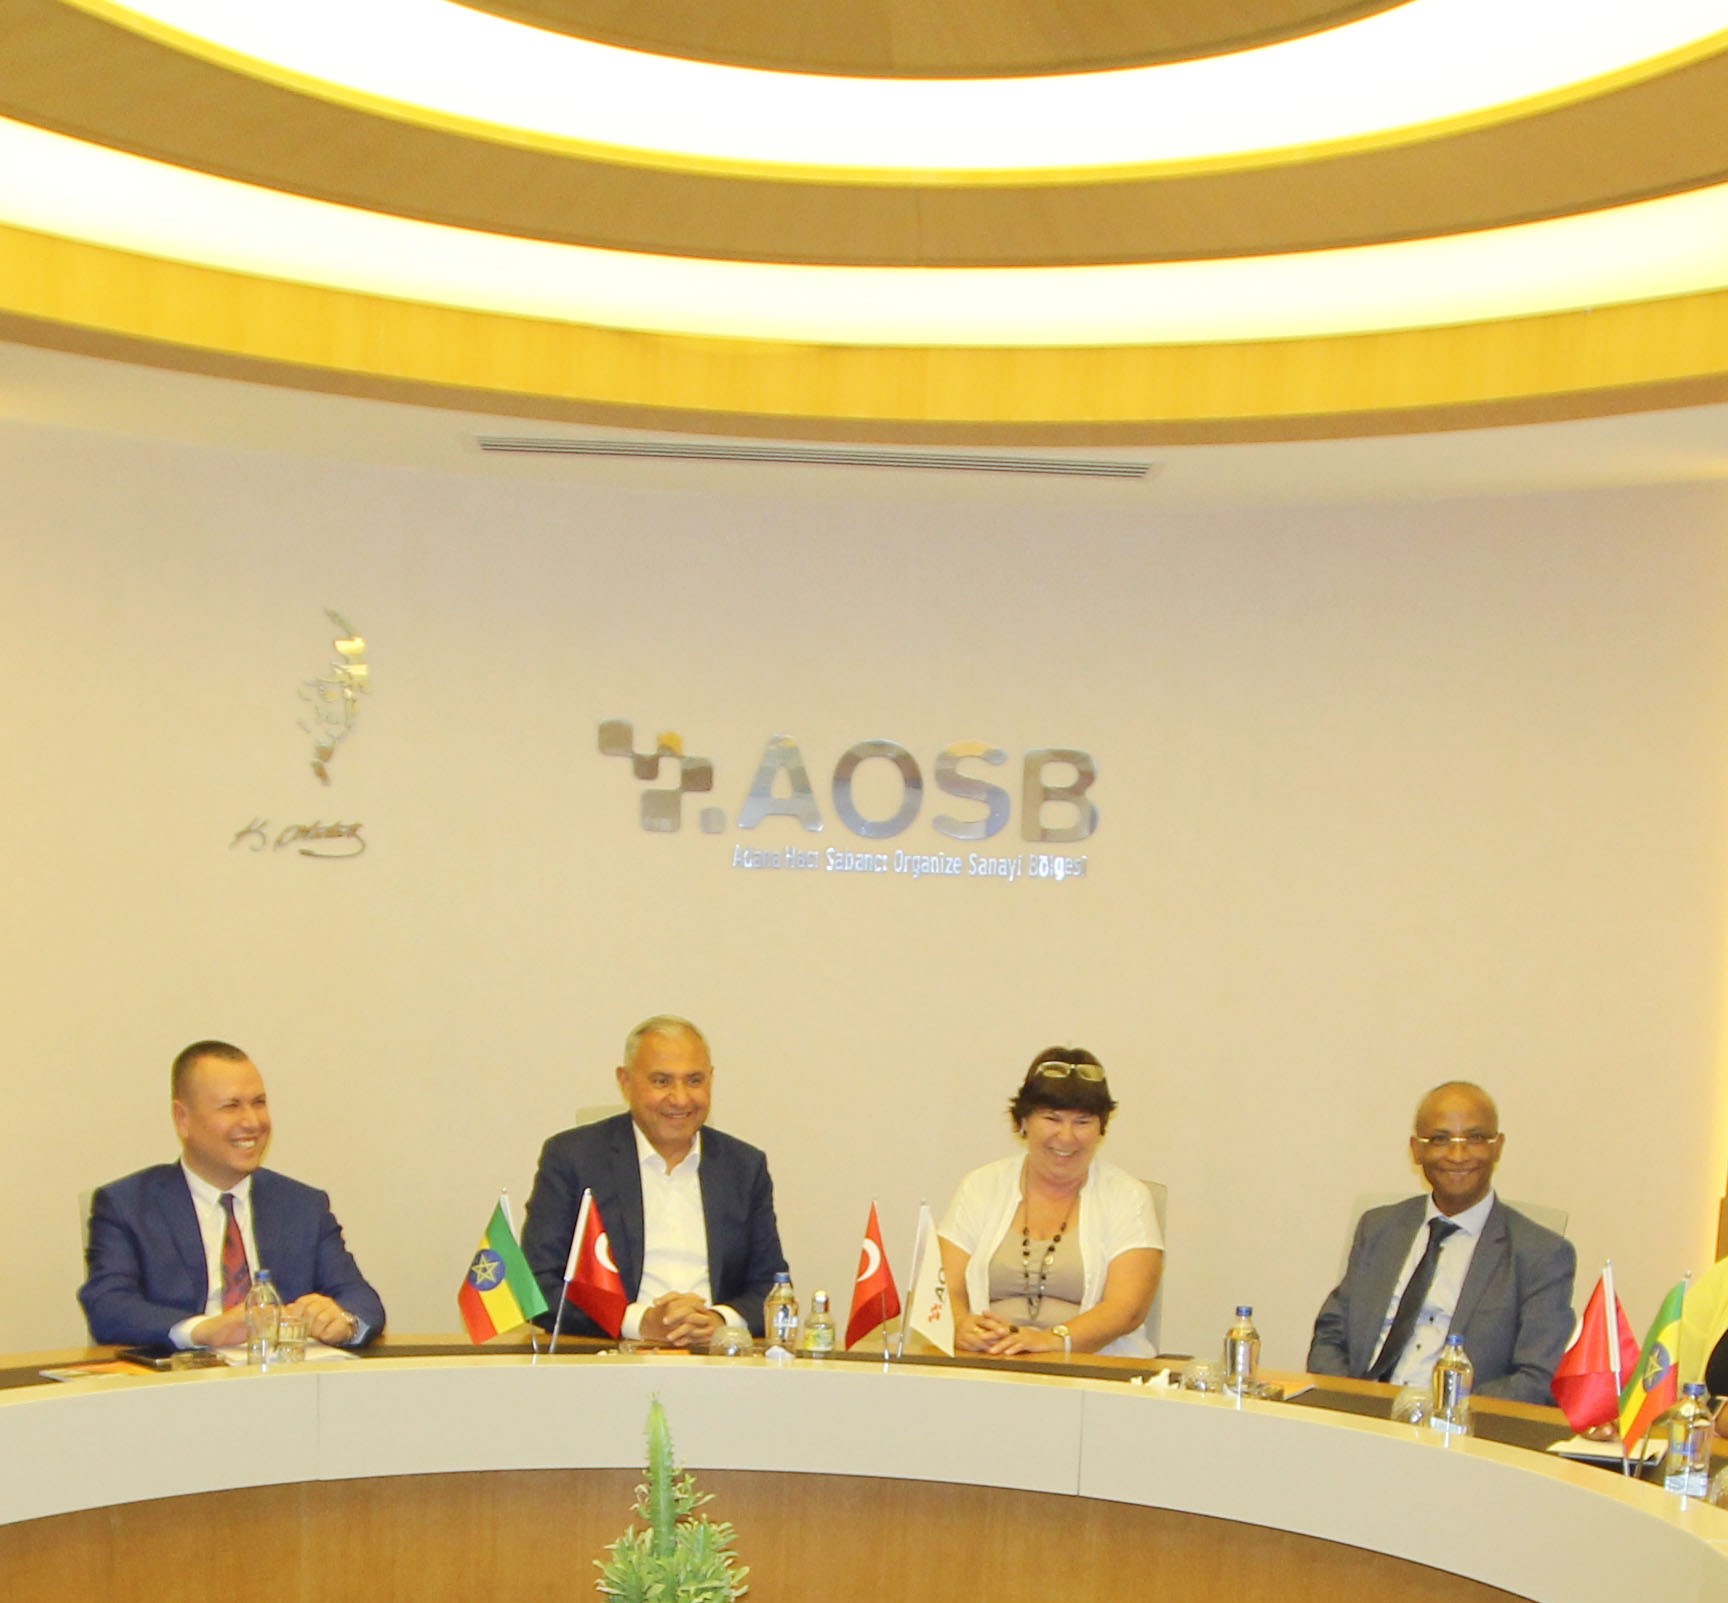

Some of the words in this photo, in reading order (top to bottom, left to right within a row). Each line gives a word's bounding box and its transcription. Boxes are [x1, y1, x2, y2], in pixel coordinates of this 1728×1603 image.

[736, 734, 1100, 843] AOSB
[732, 844, 781, 870] Adana
[893, 849, 962, 879] Organize
[968, 852, 1022, 882] Sanayi
[1028, 853, 1089, 882] Bölgesi
